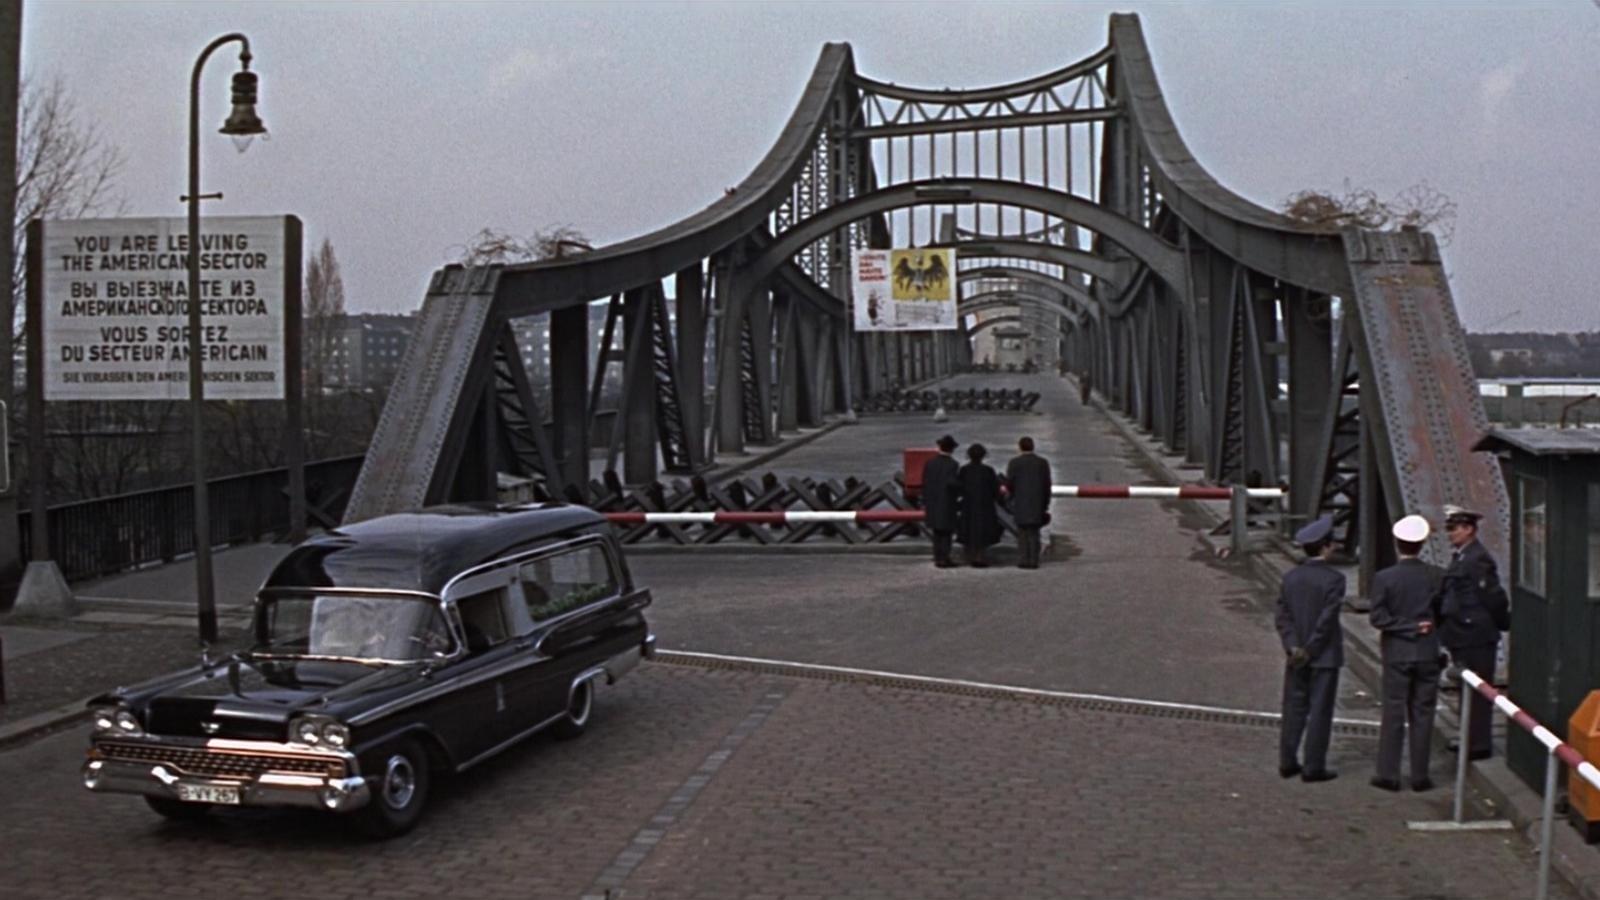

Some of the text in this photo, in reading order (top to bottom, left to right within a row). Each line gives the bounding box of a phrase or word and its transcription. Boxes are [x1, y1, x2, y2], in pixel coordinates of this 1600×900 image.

[75, 234, 248, 252] YOU ARE LEVING
[62, 253, 267, 271] THE AMERICAN SECTOR
[71, 280, 256, 298] ВЫ ВЫЕЗЖАТЕ ИЗ
[200, 299, 268, 316] СЕКТОРА
[101, 326, 228, 342] VOUS SOREZ
[61, 345, 84, 362] DU
[89, 345, 164, 361] SECTEUR
[63, 371, 80, 383] SIE
[136, 371, 155, 382] DEN
[158, 371, 241, 382] AMERINISCHEN
